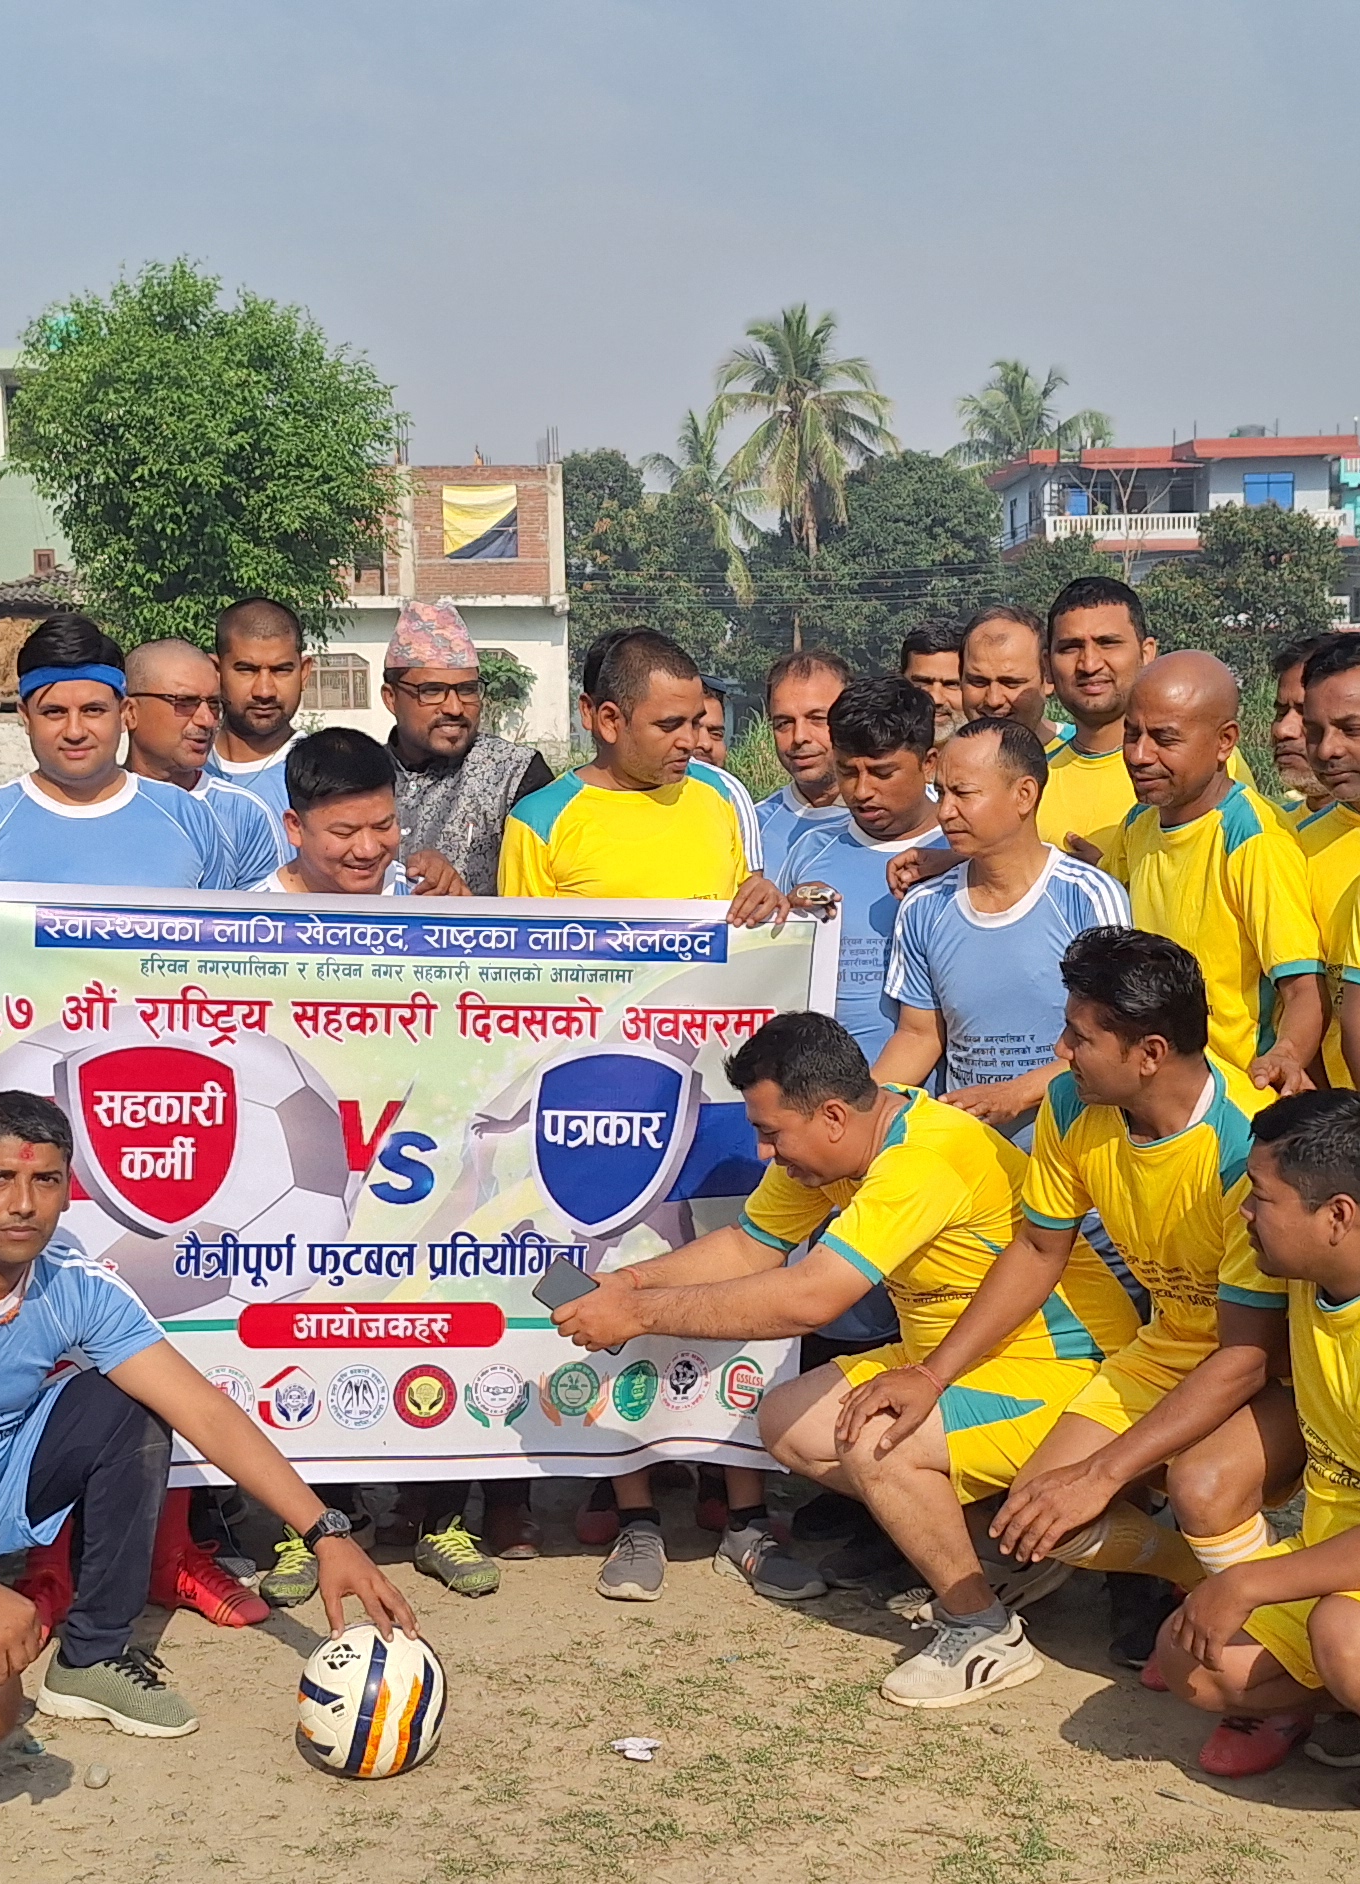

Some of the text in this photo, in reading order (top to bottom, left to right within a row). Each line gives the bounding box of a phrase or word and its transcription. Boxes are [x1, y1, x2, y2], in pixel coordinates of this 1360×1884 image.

[42, 914, 715, 961] स्वास्थ्यका लागि खेलकुद, राष्ट्रका लागि खेलकुद
[140, 953, 634, 985] हरिवन नगरपालिका र हरिवन नगर सहकारी संजालको आयोजनामा
[135, 985, 273, 1048] राष्ट्रिय
[291, 991, 439, 1044] सहकारी
[455, 991, 604, 1045] दिवसको
[621, 1005, 776, 1048] अवसरमा
[93, 1080, 227, 1128] सहकारी
[543, 1110, 666, 1148] पत्रकार
[120, 1136, 196, 1180] कर्मी
[175, 1231, 588, 1287] मैत्रीपूर्ण फुटबल प्रतियोगिता
